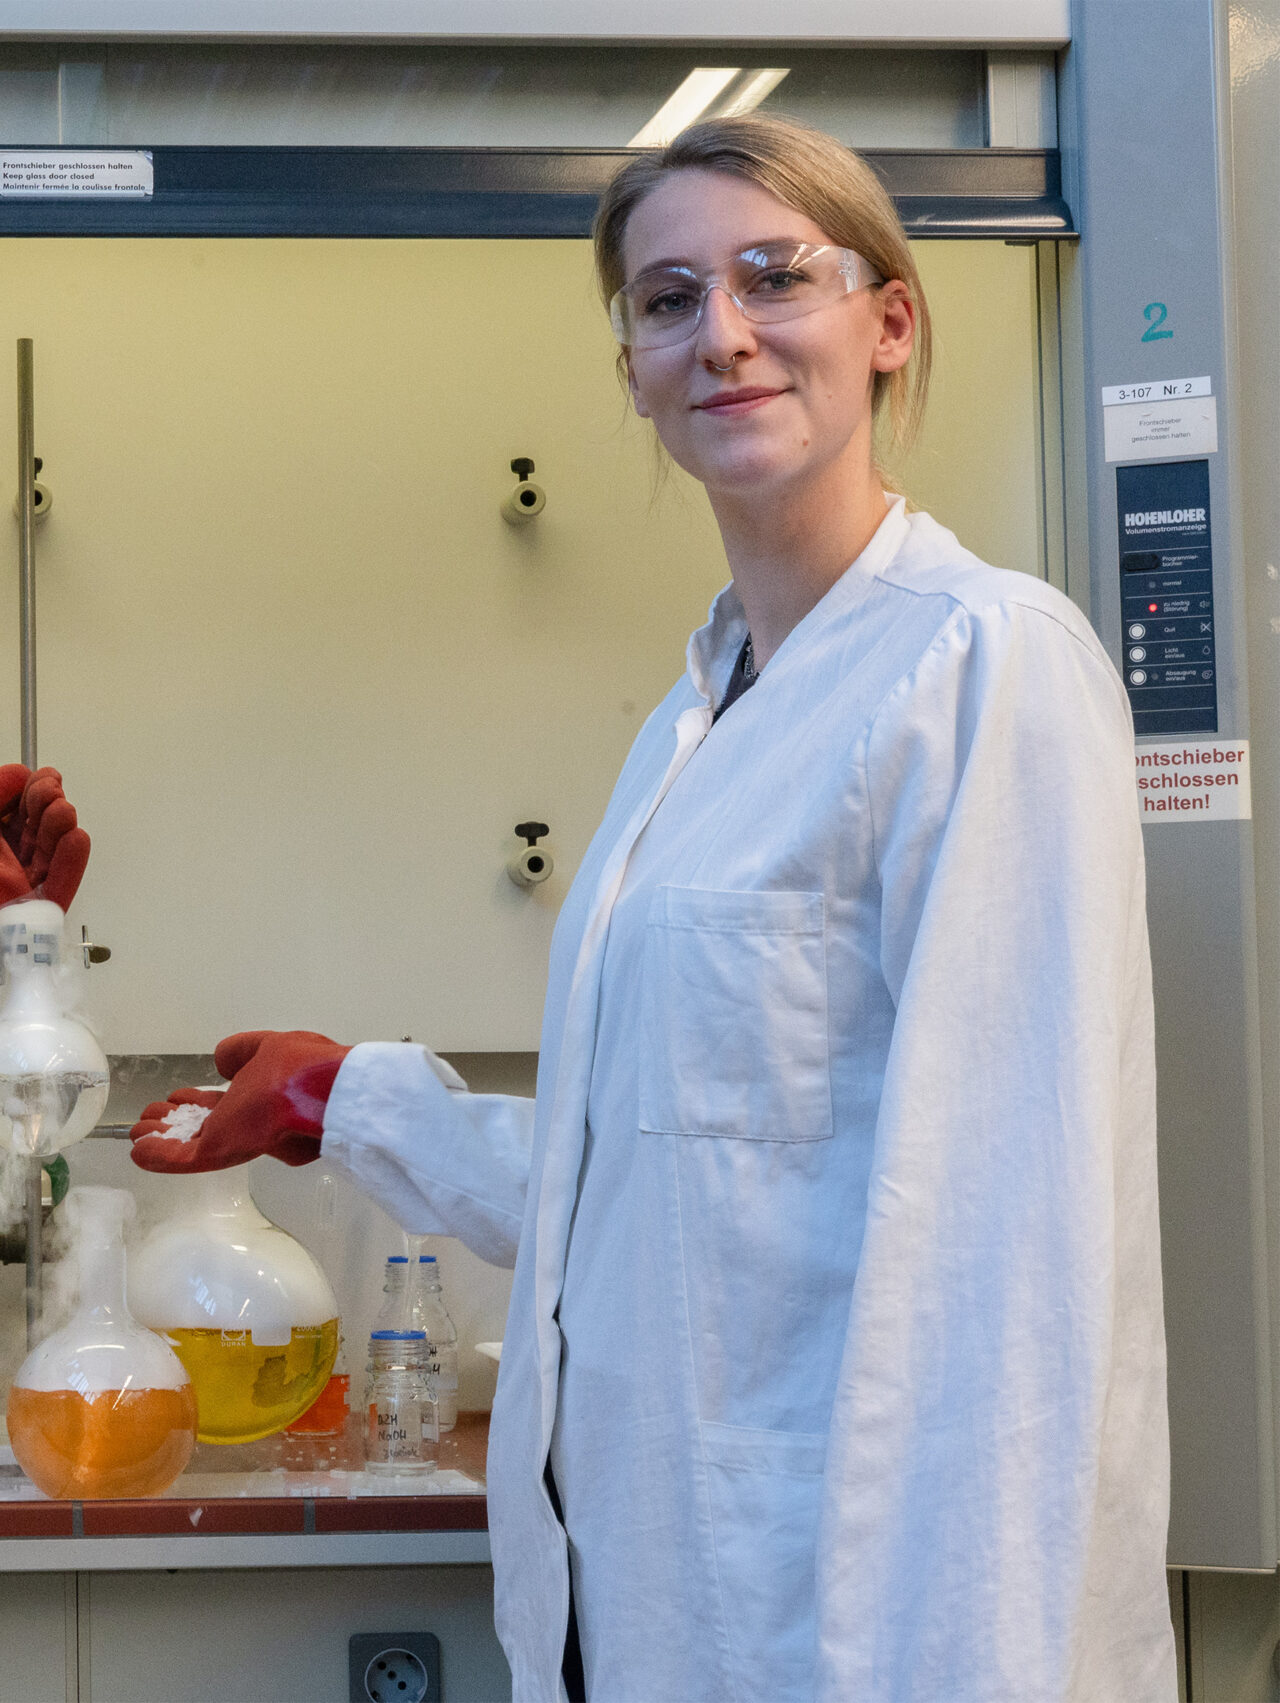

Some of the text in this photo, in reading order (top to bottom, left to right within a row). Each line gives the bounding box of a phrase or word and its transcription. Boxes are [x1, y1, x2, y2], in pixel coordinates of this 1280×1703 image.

[58, 162, 105, 171] geschlossen
[1141, 302, 1174, 343] 2
[1119, 383, 1192, 400] 3-107 Nr. 2
[1131, 434, 1170, 443] geschlossen
[1124, 508, 1206, 527] HOHENLOHER
[1125, 524, 1207, 535] Volumenstromanzeige
[1135, 748, 1245, 767] ntschieber
[1138, 772, 1239, 790] schlossen
[1144, 794, 1210, 812] halten!
[378, 1429, 407, 1441] NaOH
